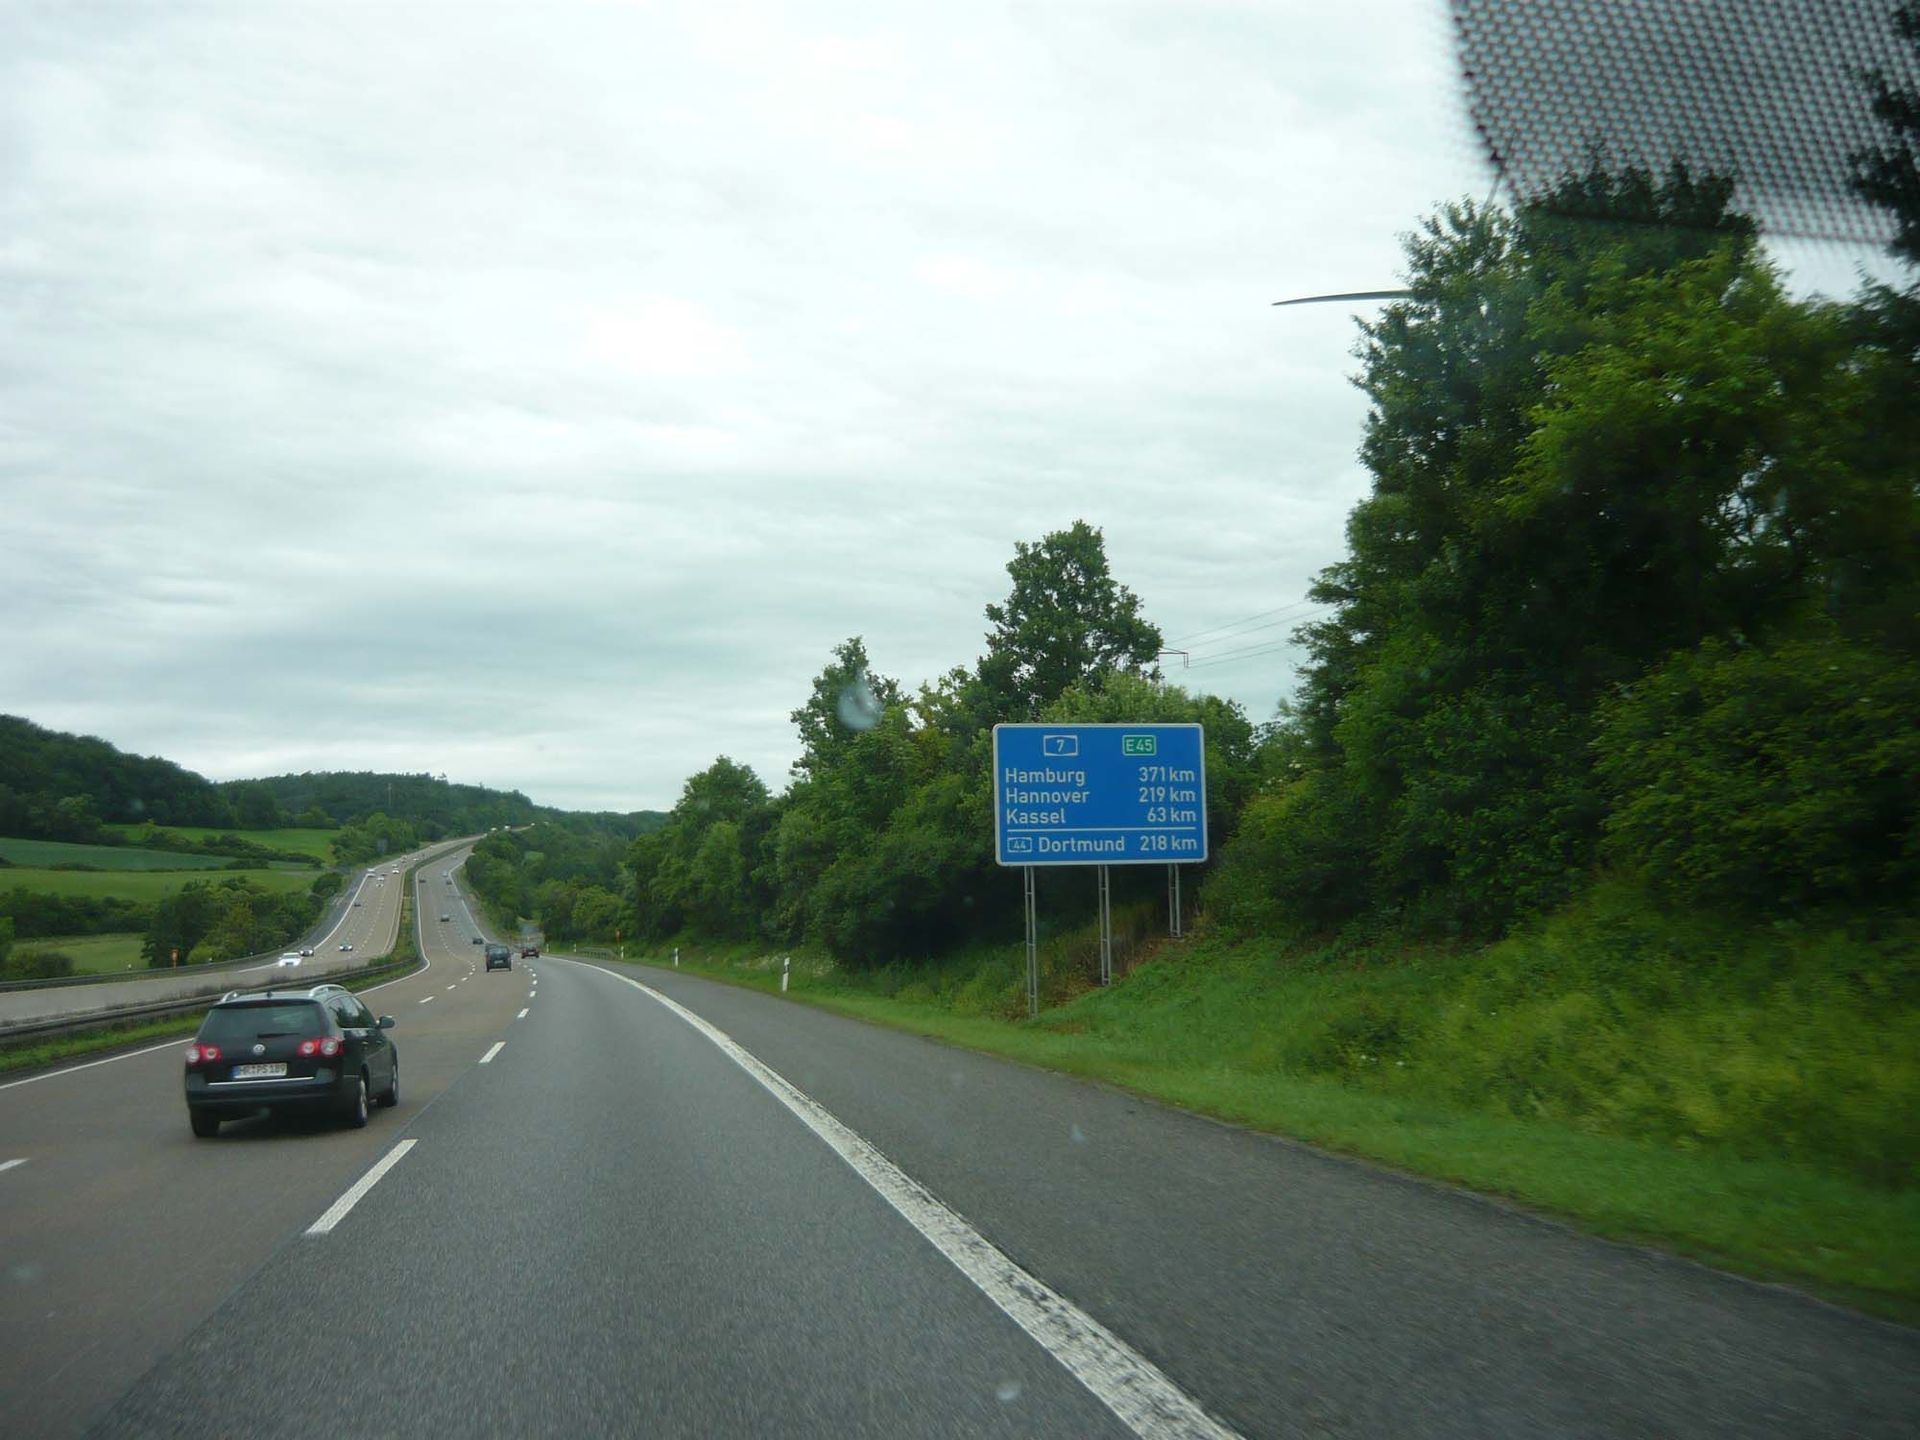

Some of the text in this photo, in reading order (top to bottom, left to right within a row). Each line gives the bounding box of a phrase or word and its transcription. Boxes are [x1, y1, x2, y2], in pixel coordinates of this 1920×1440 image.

[1056, 739, 1065, 753] 7
[1005, 767, 1195, 786] Hamburg 371 km
[1006, 787, 1195, 803] Hannover 219 km
[1006, 808, 1196, 824] Kassel 63 km
[1013, 836, 1197, 852] 44 Dortmund 218 km
